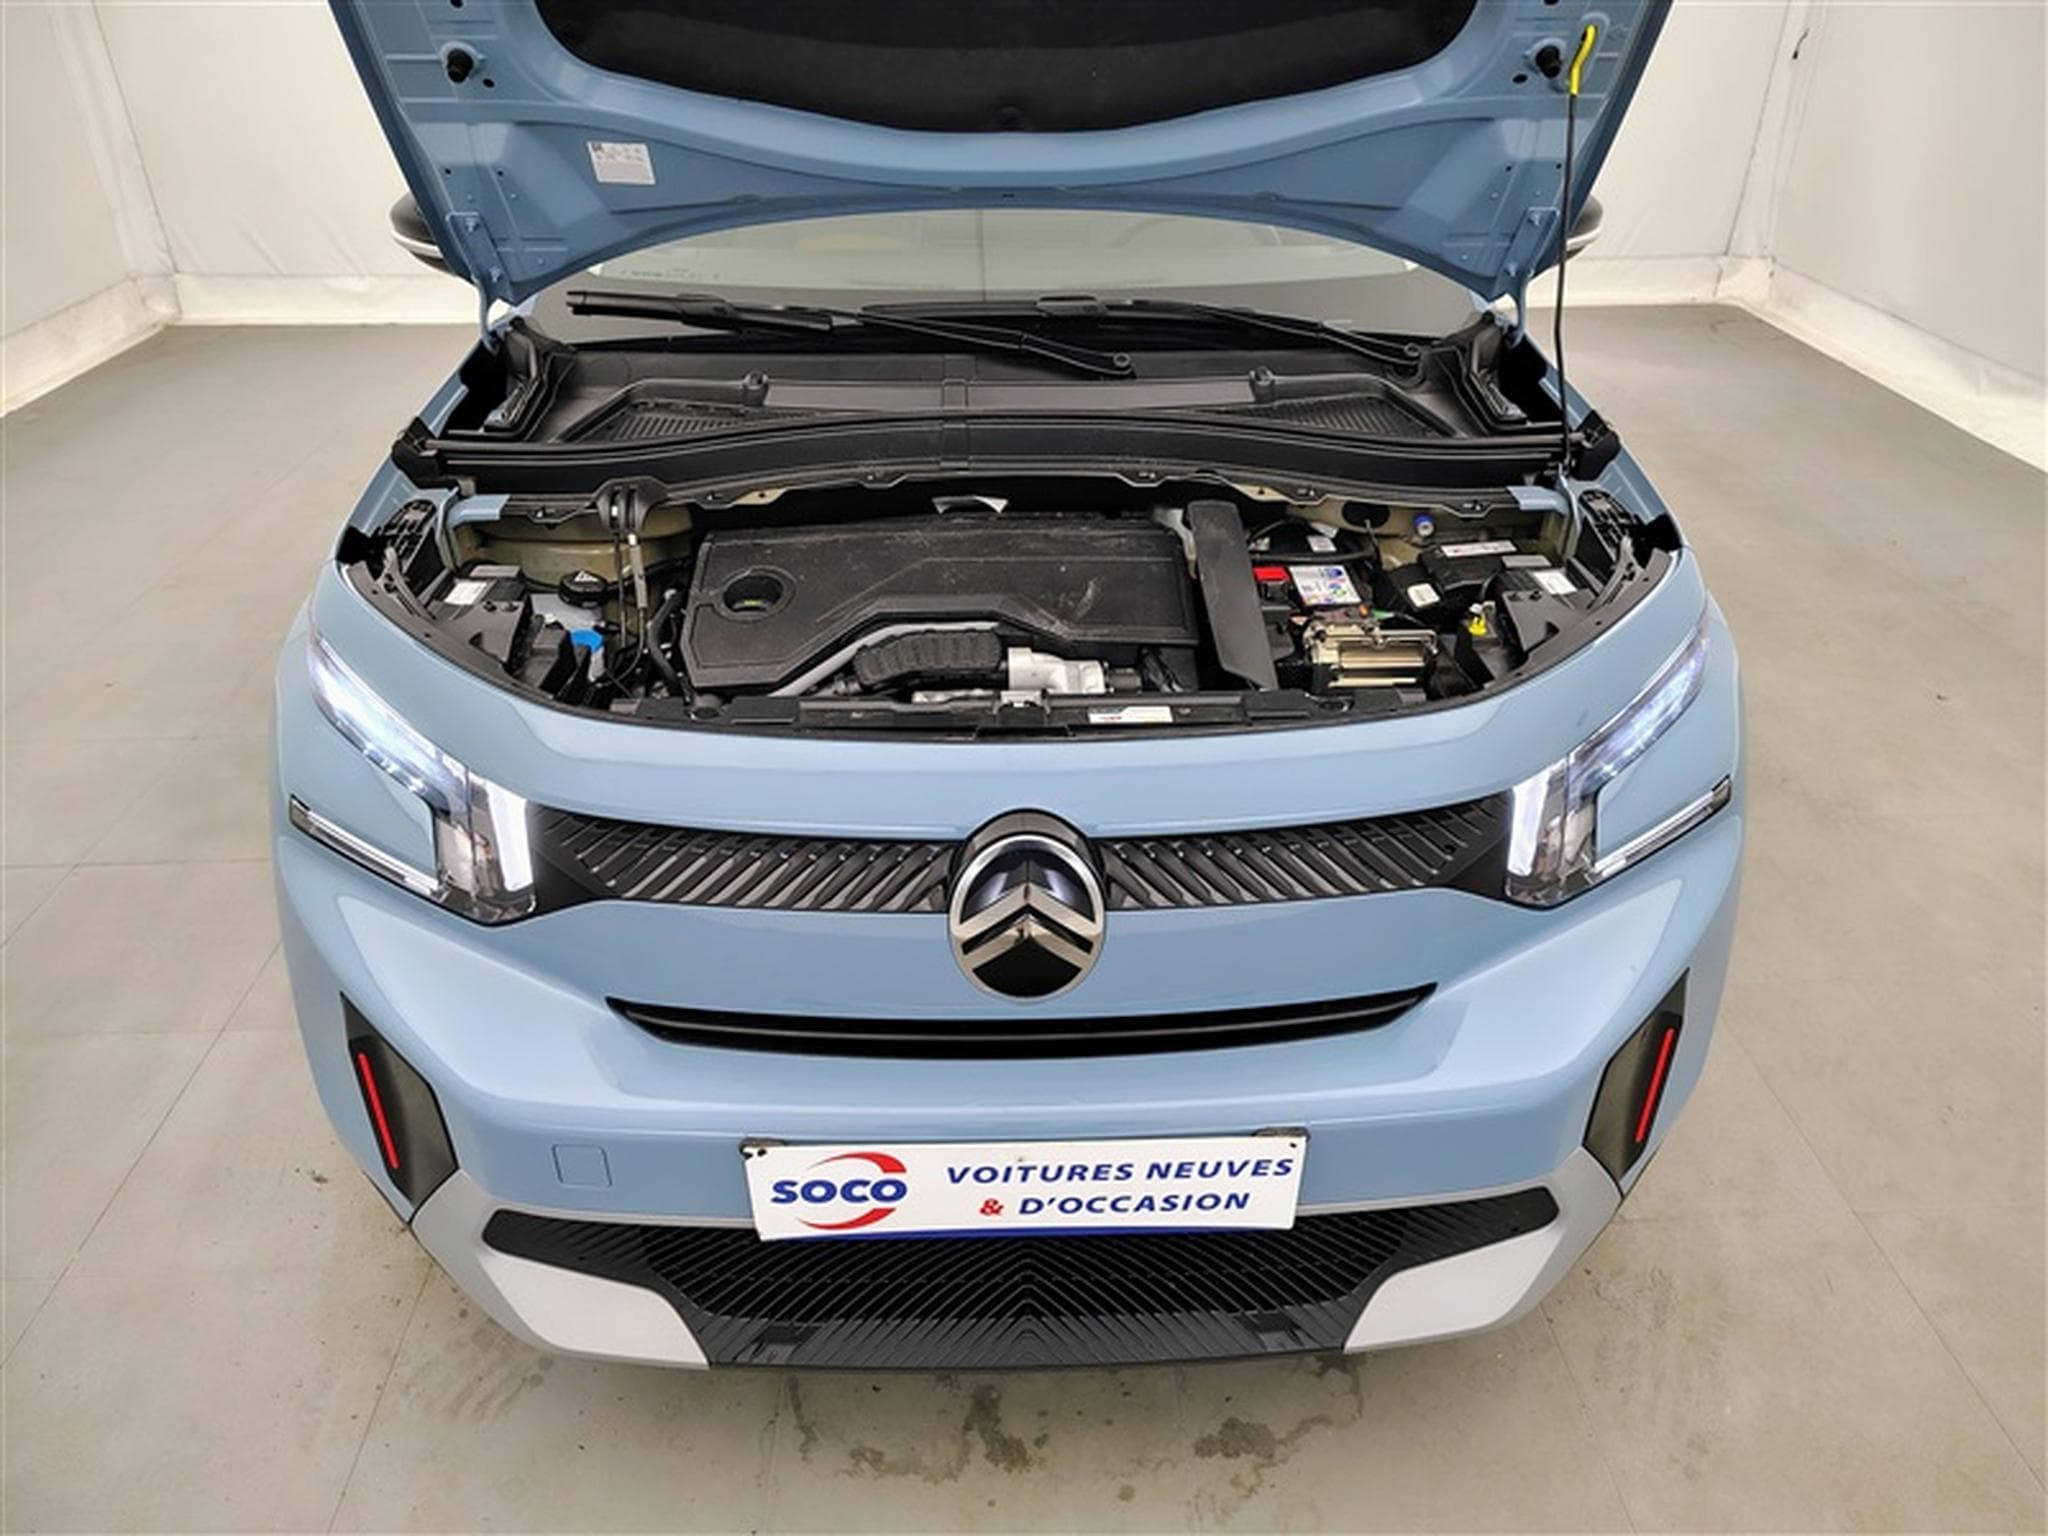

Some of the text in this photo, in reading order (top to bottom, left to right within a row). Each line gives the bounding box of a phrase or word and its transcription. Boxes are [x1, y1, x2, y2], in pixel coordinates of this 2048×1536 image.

[946, 1158, 1293, 1185] VOITURES NEUVES
[771, 1178, 908, 1204] SOCO
[979, 1192, 1250, 1217] & D'OCCASION
